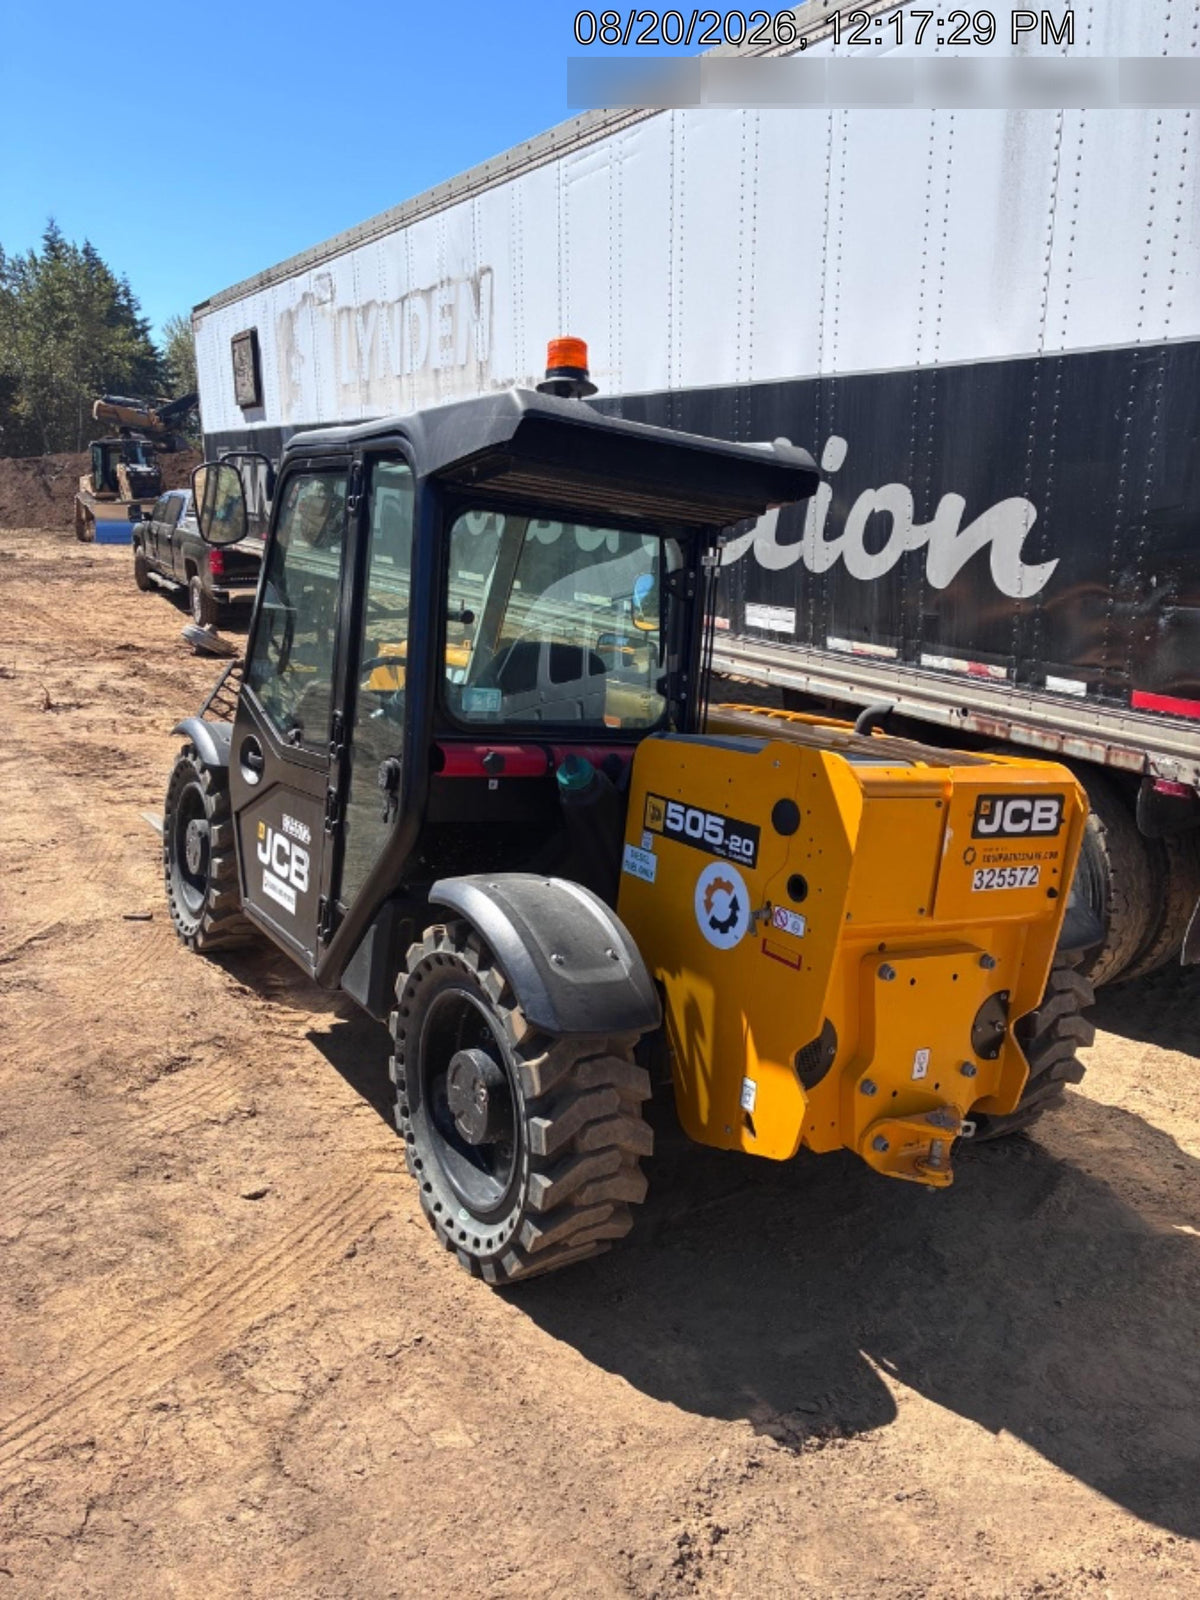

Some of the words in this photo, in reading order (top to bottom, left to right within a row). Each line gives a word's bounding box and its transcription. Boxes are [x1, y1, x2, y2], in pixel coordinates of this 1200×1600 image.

[977, 799, 1060, 833] JCB
[257, 827, 311, 894] JCB
[973, 866, 1040, 890] 325572
